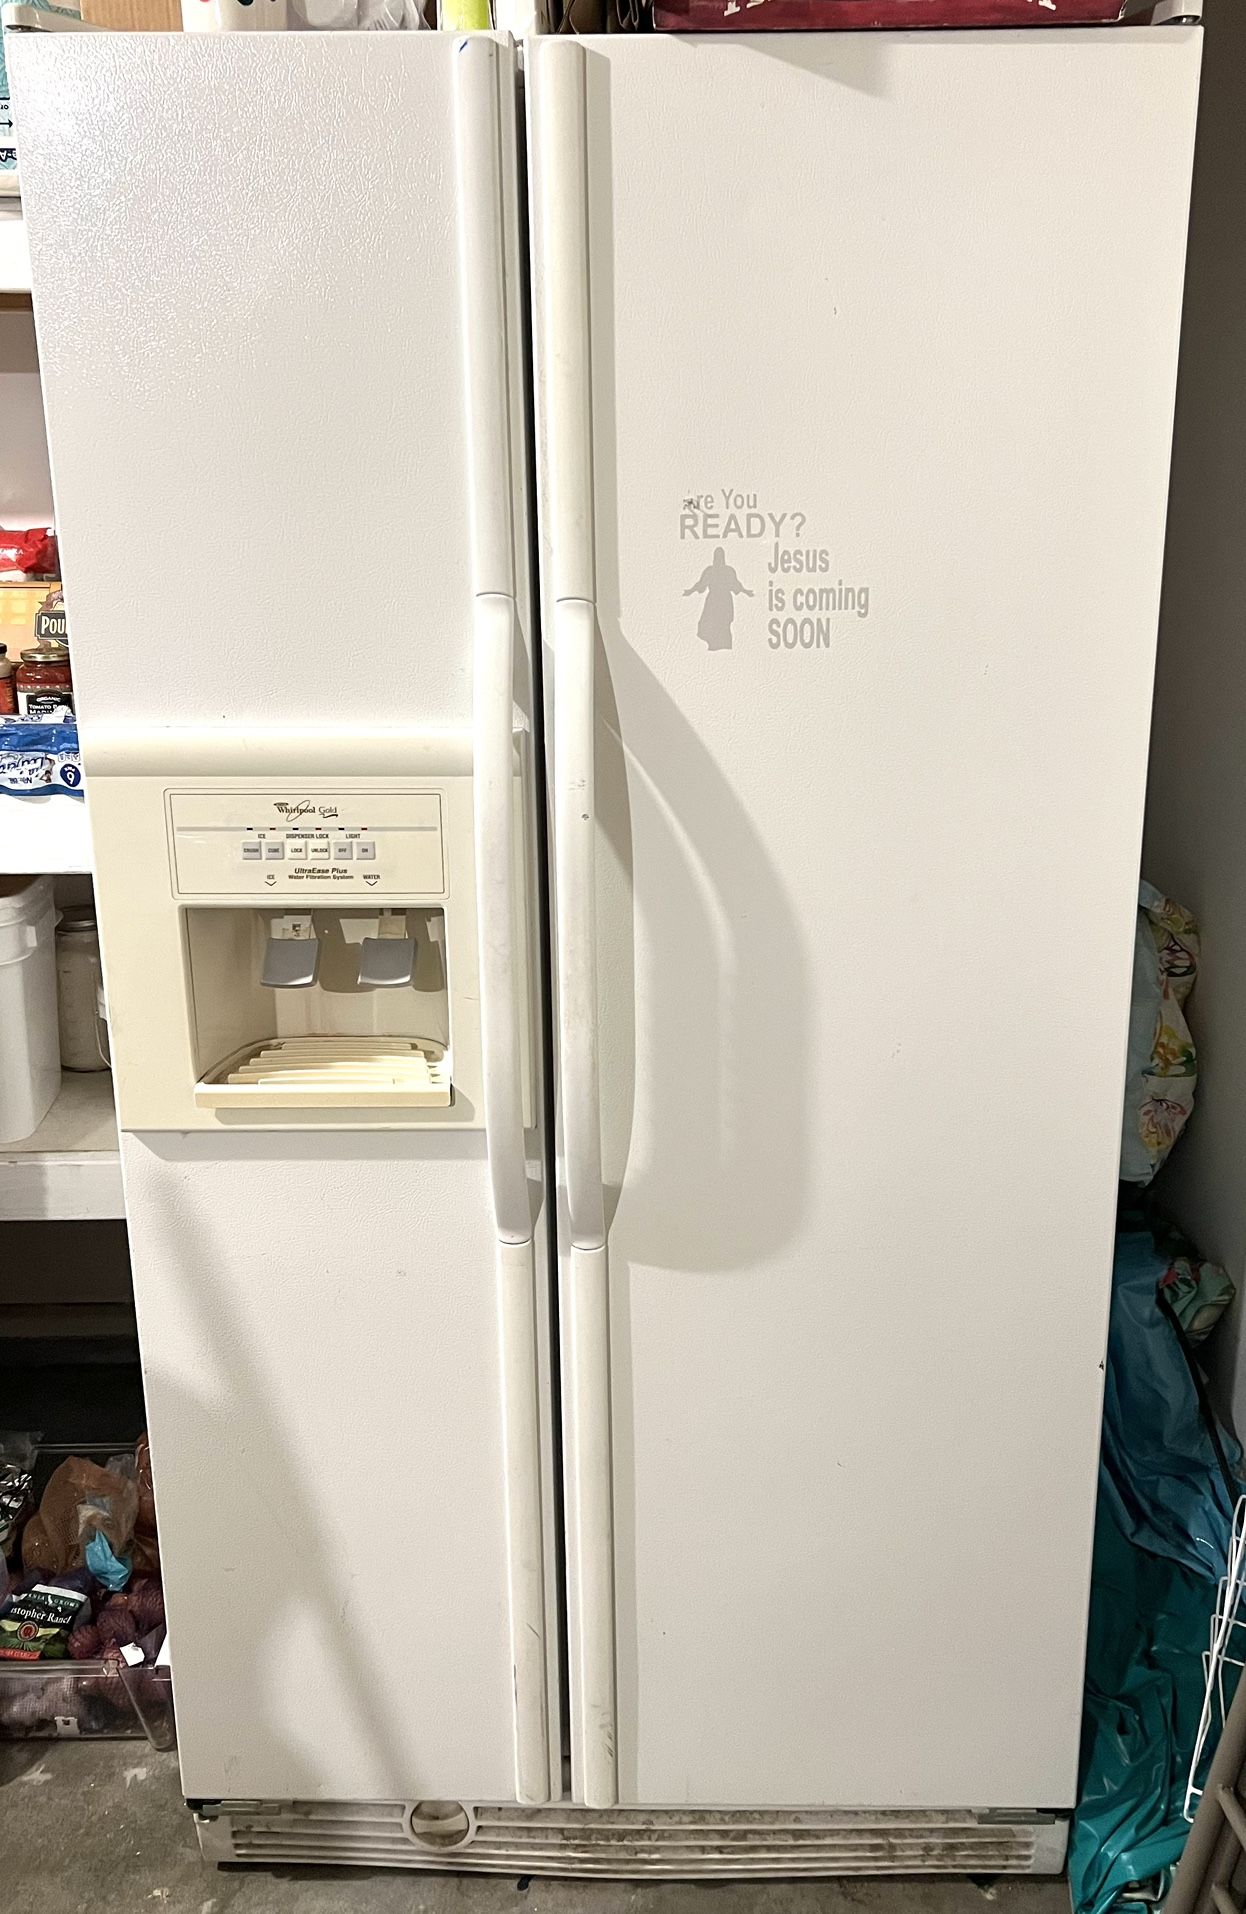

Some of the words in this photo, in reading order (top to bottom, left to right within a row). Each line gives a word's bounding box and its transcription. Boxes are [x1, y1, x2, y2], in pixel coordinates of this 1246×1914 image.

[721, 488, 758, 510] You
[679, 512, 807, 540] READY?
[767, 541, 830, 574] Jesus
[768, 579, 786, 612] is
[792, 579, 870, 619] coming
[767, 617, 831, 650] SOON
[67, 771, 75, 785] 6
[275, 804, 316, 817] Whirlpool
[318, 805, 339, 818] Gold
